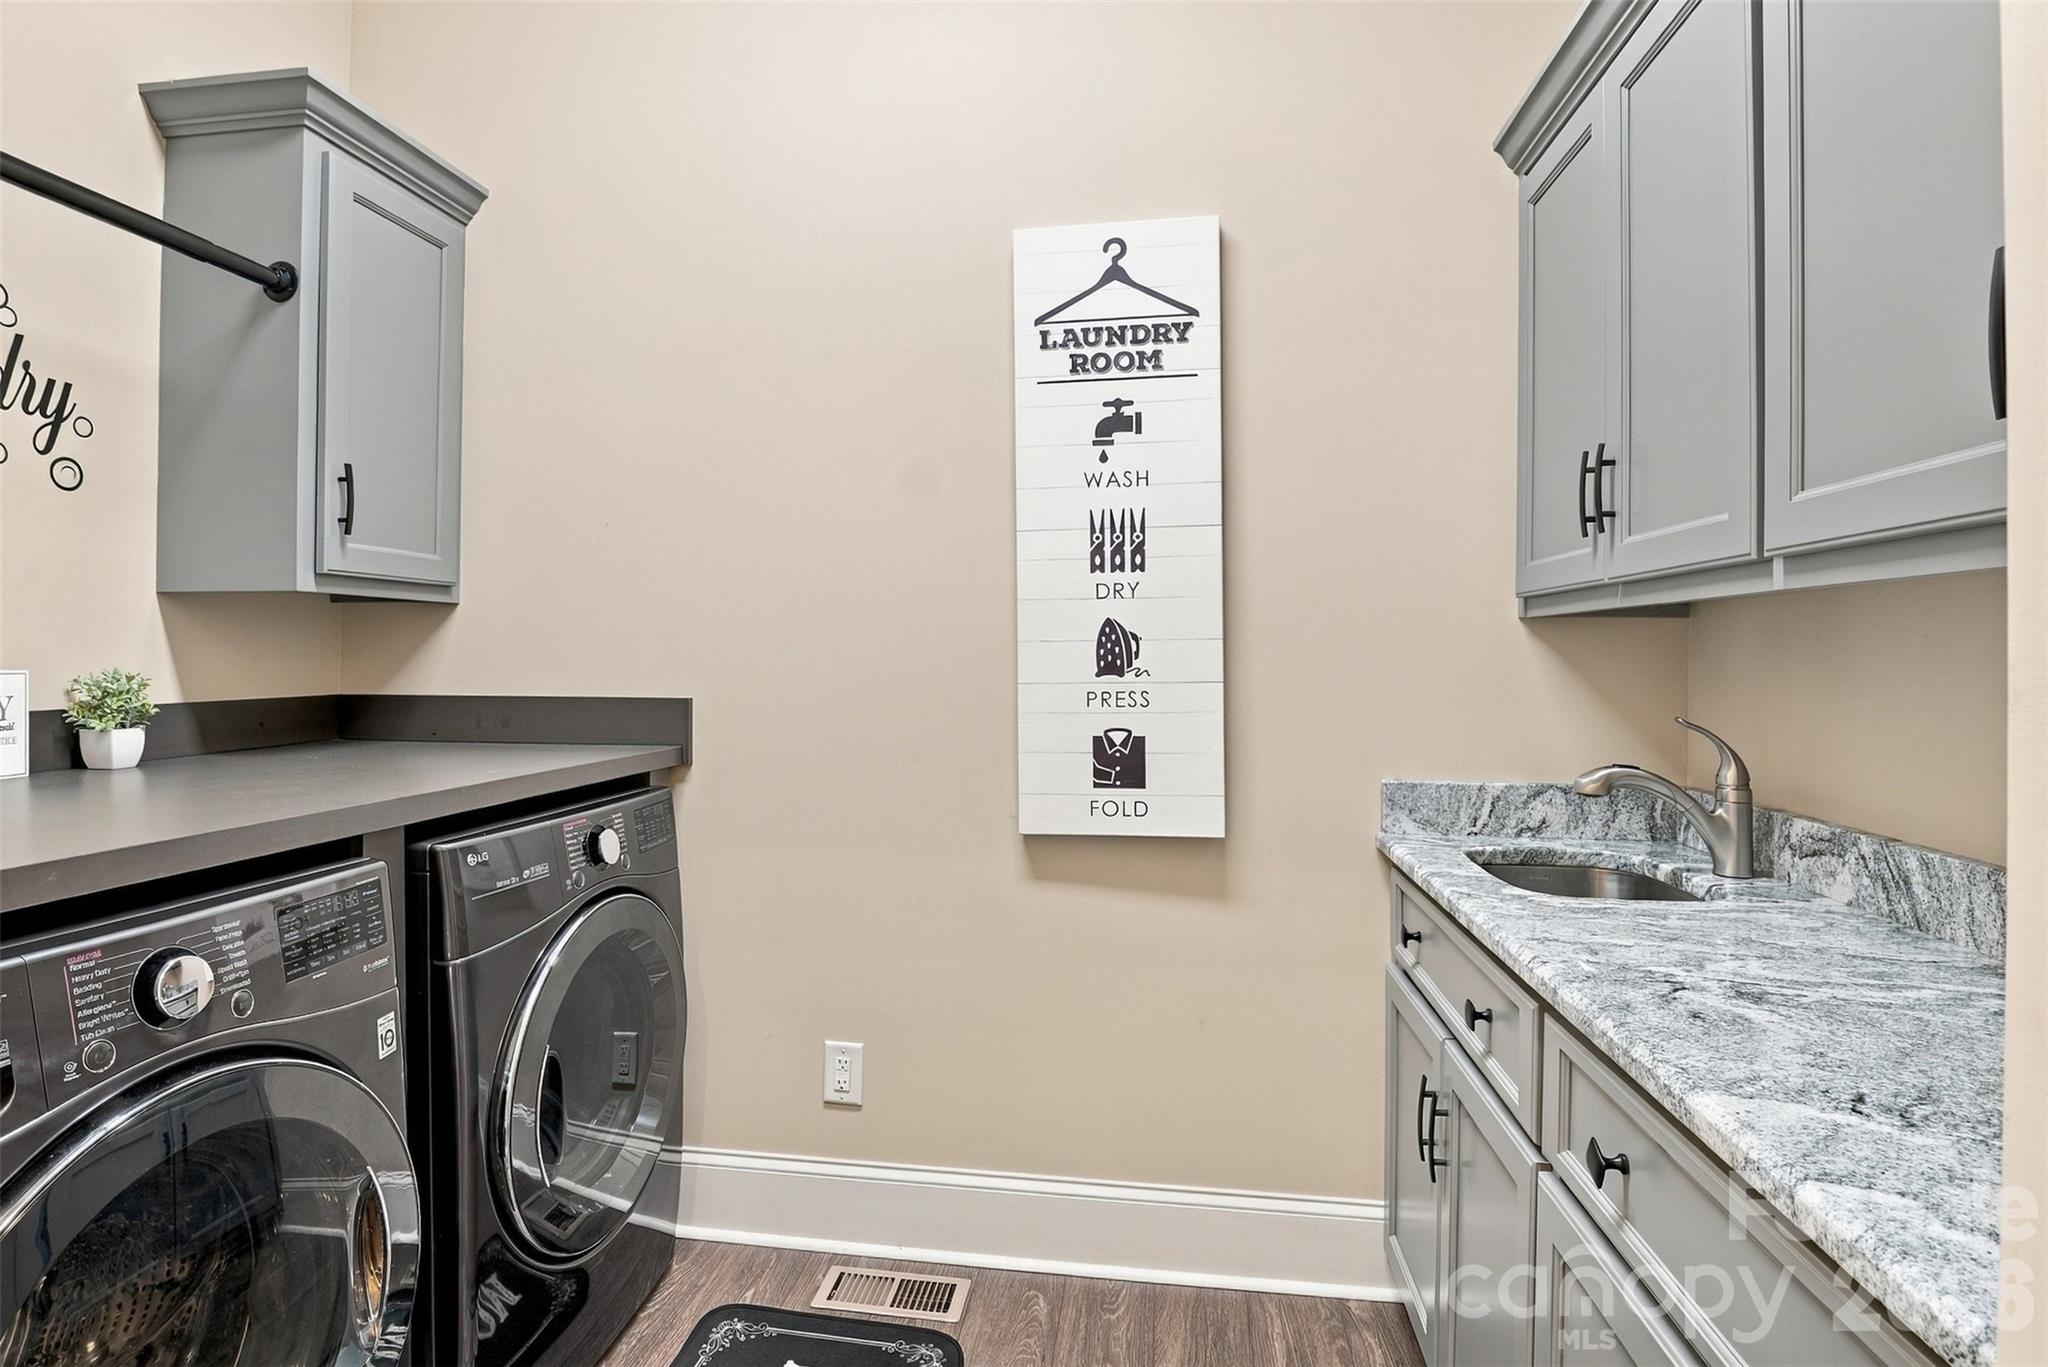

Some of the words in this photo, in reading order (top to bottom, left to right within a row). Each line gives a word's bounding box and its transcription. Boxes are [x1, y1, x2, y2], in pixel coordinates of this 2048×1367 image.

[1039, 321, 1194, 350] LAUNDRY
[1069, 349, 1164, 375] ROOM
[1083, 470, 1150, 488] WASH
[1096, 582, 1140, 600] DRY
[1087, 690, 1151, 708] PRESS
[1090, 800, 1149, 817] FOLD
[69, 960, 95, 971] Normal
[72, 972, 94, 983] Heavy
[95, 966, 112, 977] Duty
[73, 981, 102, 995] Bedding
[75, 992, 105, 1007] Sanitary
[80, 1032, 95, 1042] Tub
[95, 1025, 115, 1037] Clean
[380, 1029, 394, 1051] 10
